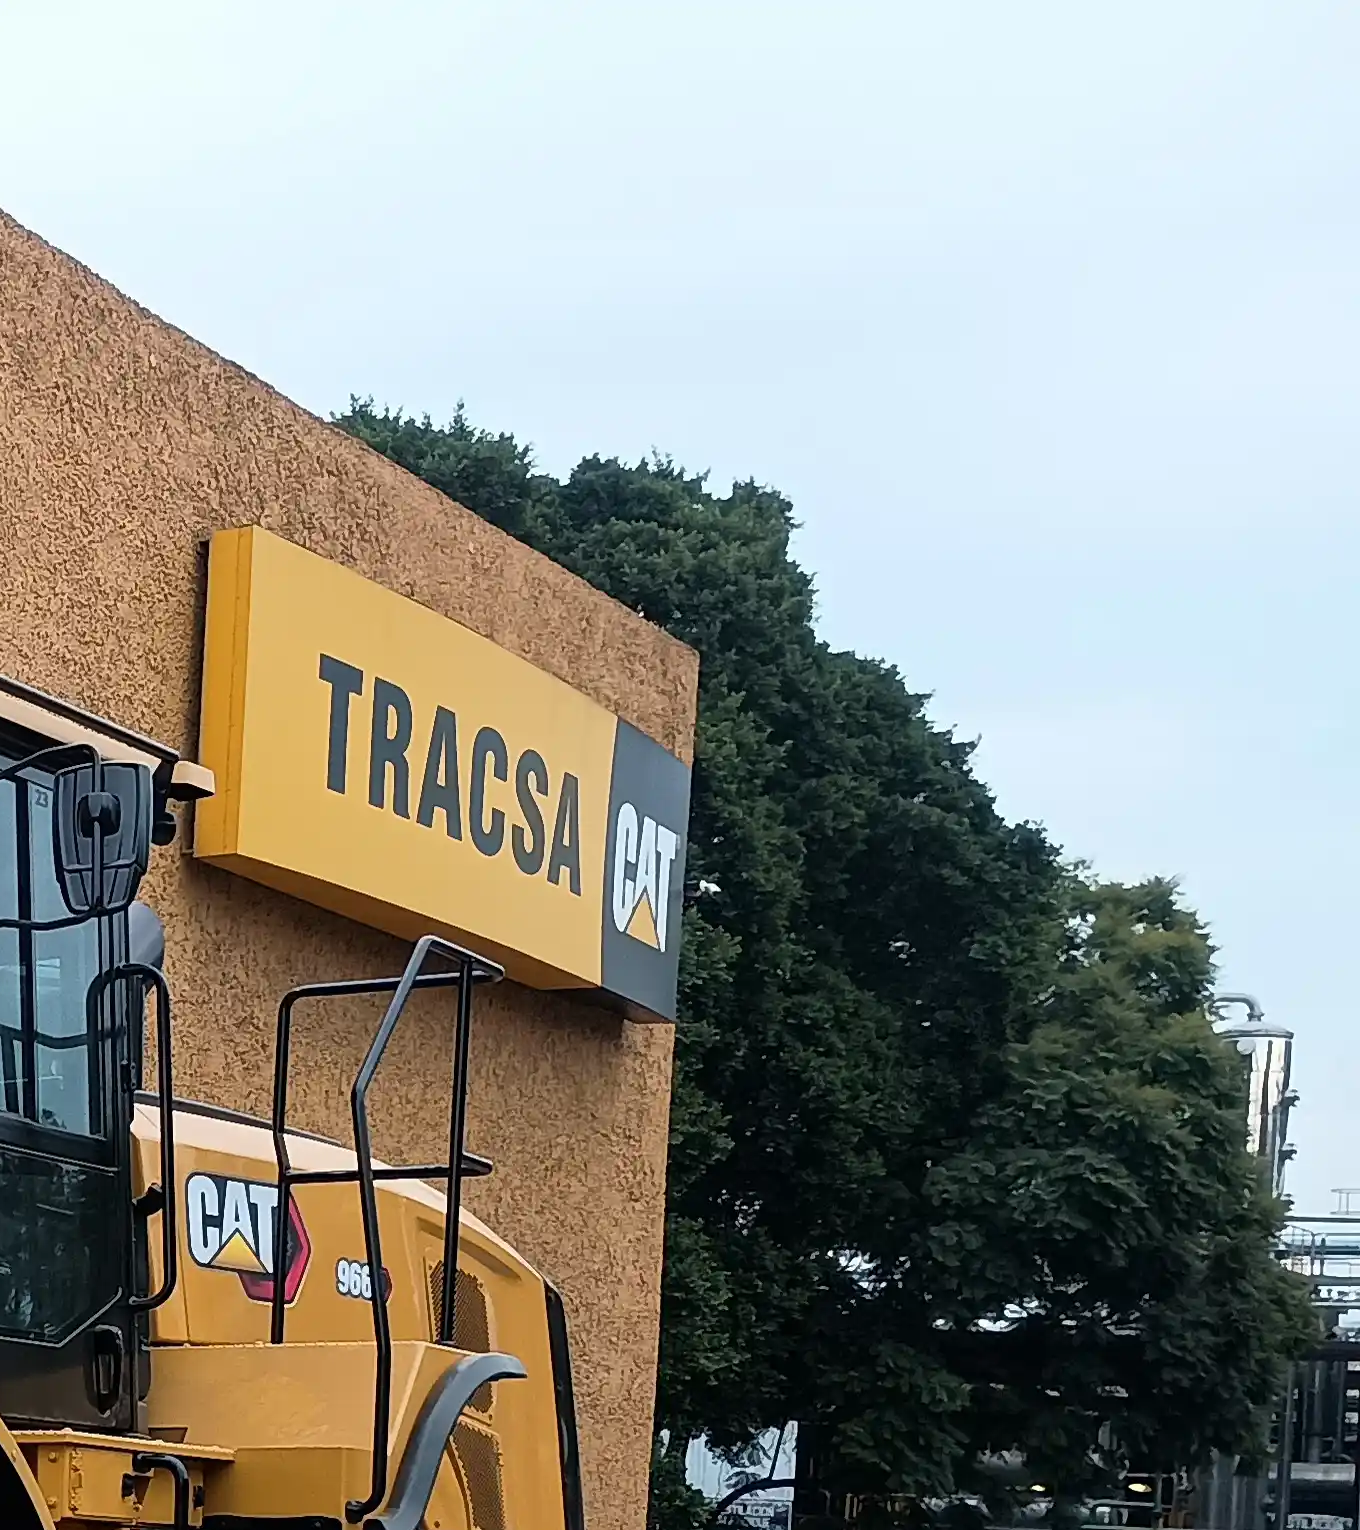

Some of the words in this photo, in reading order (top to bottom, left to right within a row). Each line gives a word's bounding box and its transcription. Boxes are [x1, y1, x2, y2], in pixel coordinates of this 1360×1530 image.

[318, 652, 581, 896] TRACSA
[612, 801, 677, 952] CAT
[187, 1175, 278, 1275] CAT
